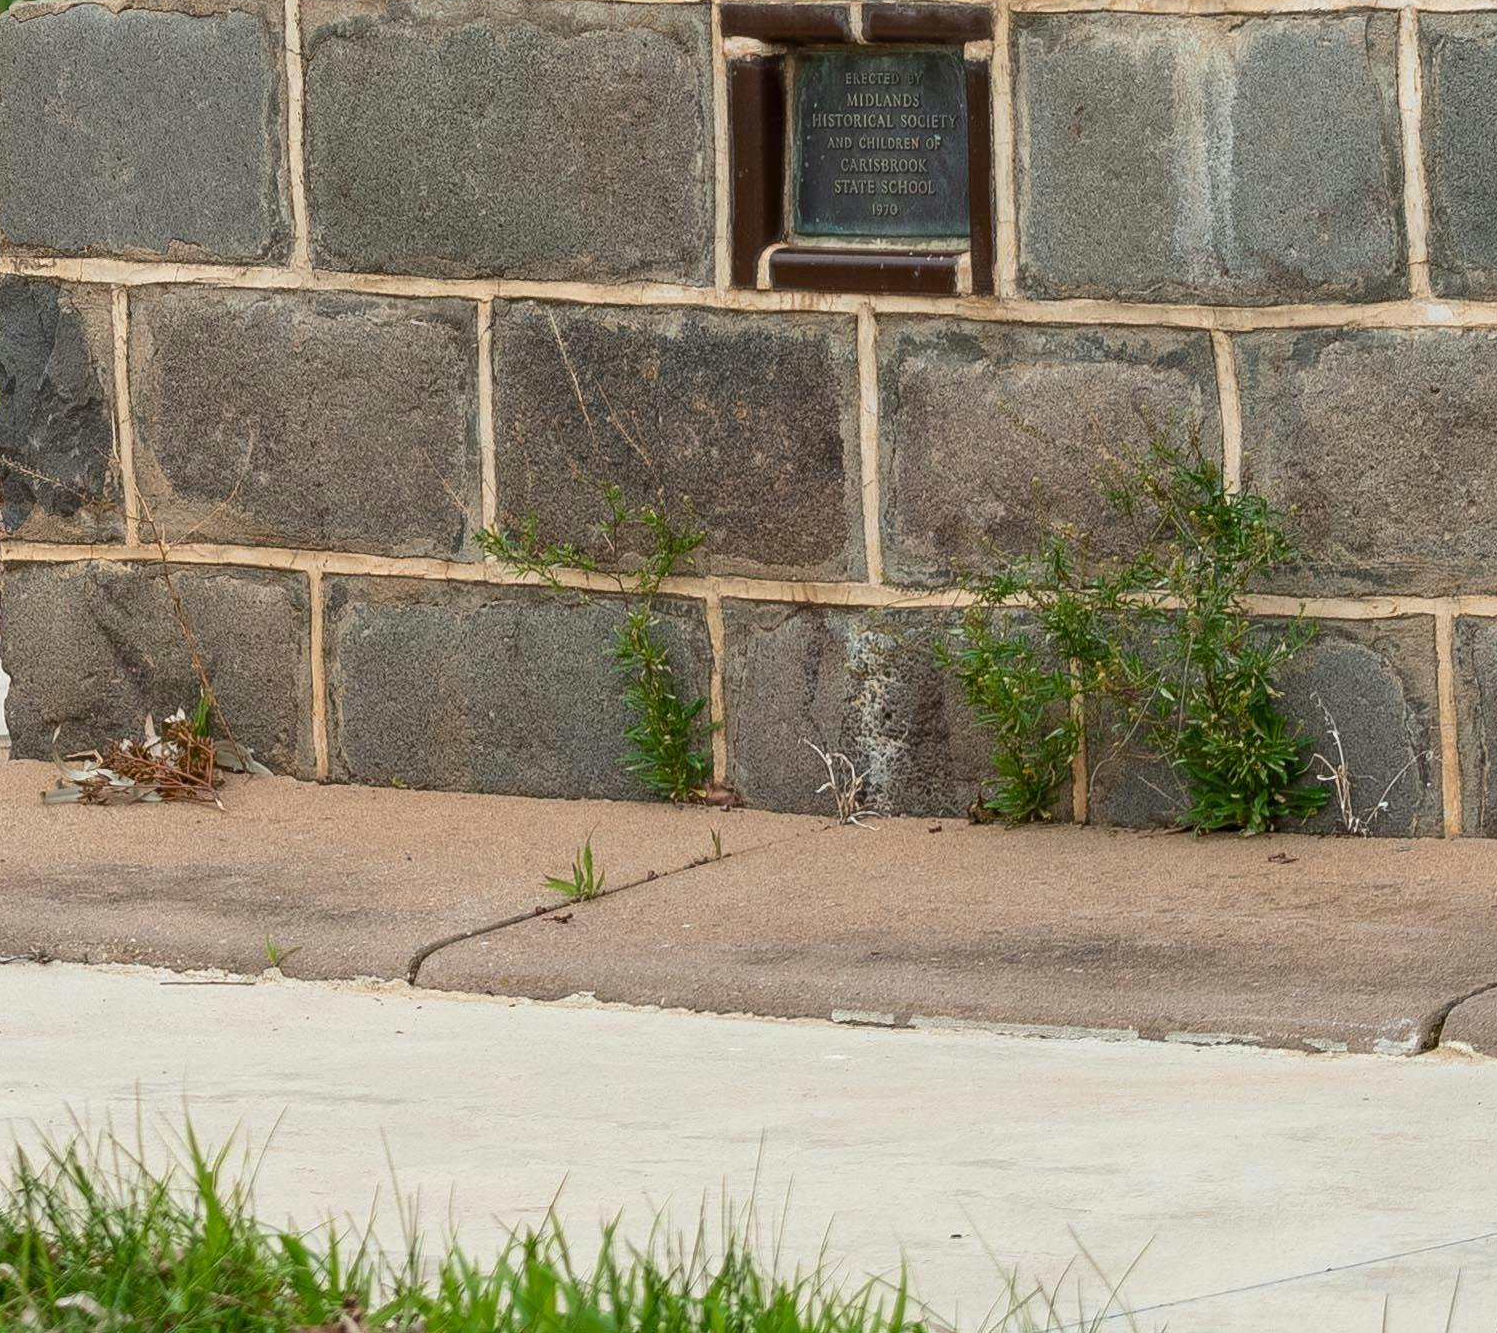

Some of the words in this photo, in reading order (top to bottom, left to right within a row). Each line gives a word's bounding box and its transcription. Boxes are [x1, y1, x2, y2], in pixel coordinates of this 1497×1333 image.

[845, 72, 900, 85] ERECTED
[907, 73, 923, 85] BY
[846, 93, 921, 108] MIDLANDS
[812, 113, 894, 128] HISTORICAL
[900, 114, 957, 128] SOCIETY
[827, 136, 852, 149] AND
[859, 136, 919, 150] CHILDREN
[925, 137, 941, 150] OF
[840, 158, 928, 173] CARISBROOK
[834, 179, 876, 194] STATE
[881, 180, 936, 195] SCHOOL
[871, 203, 899, 215] 1970
